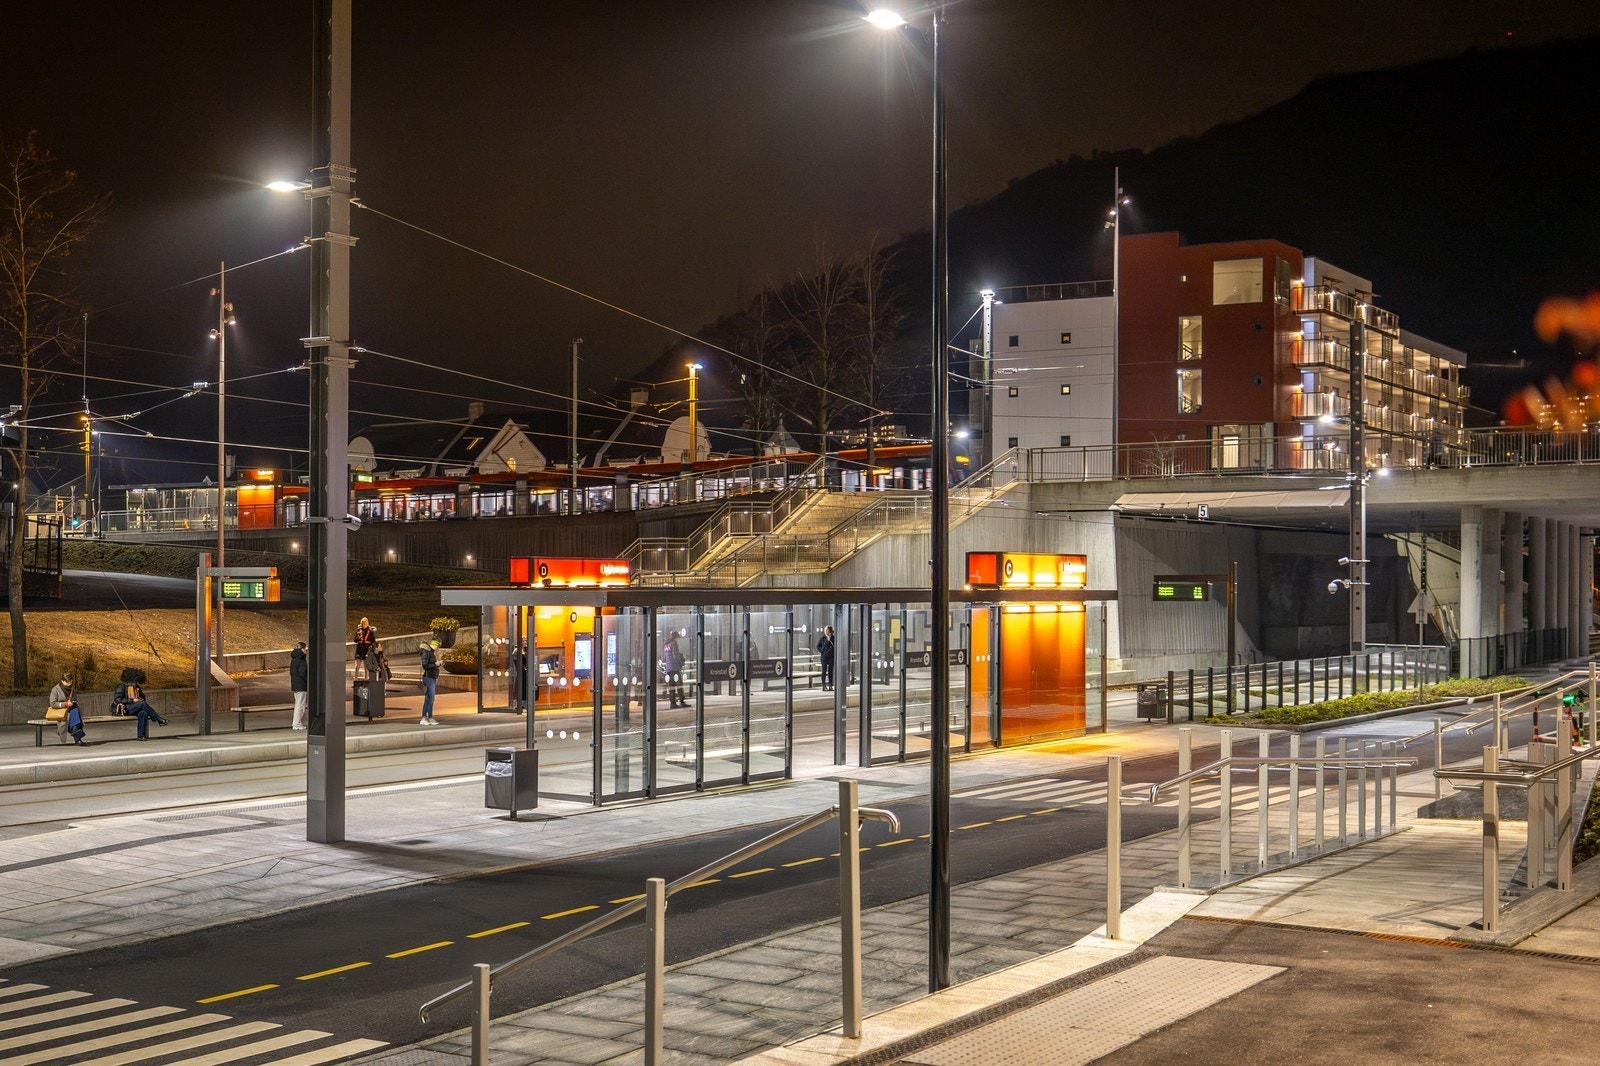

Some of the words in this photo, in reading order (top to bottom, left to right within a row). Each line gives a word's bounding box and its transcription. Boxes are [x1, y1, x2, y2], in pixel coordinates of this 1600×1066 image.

[1200, 505, 1206, 517] 5
[542, 566, 547, 575] D
[1006, 562, 1012, 575] C
